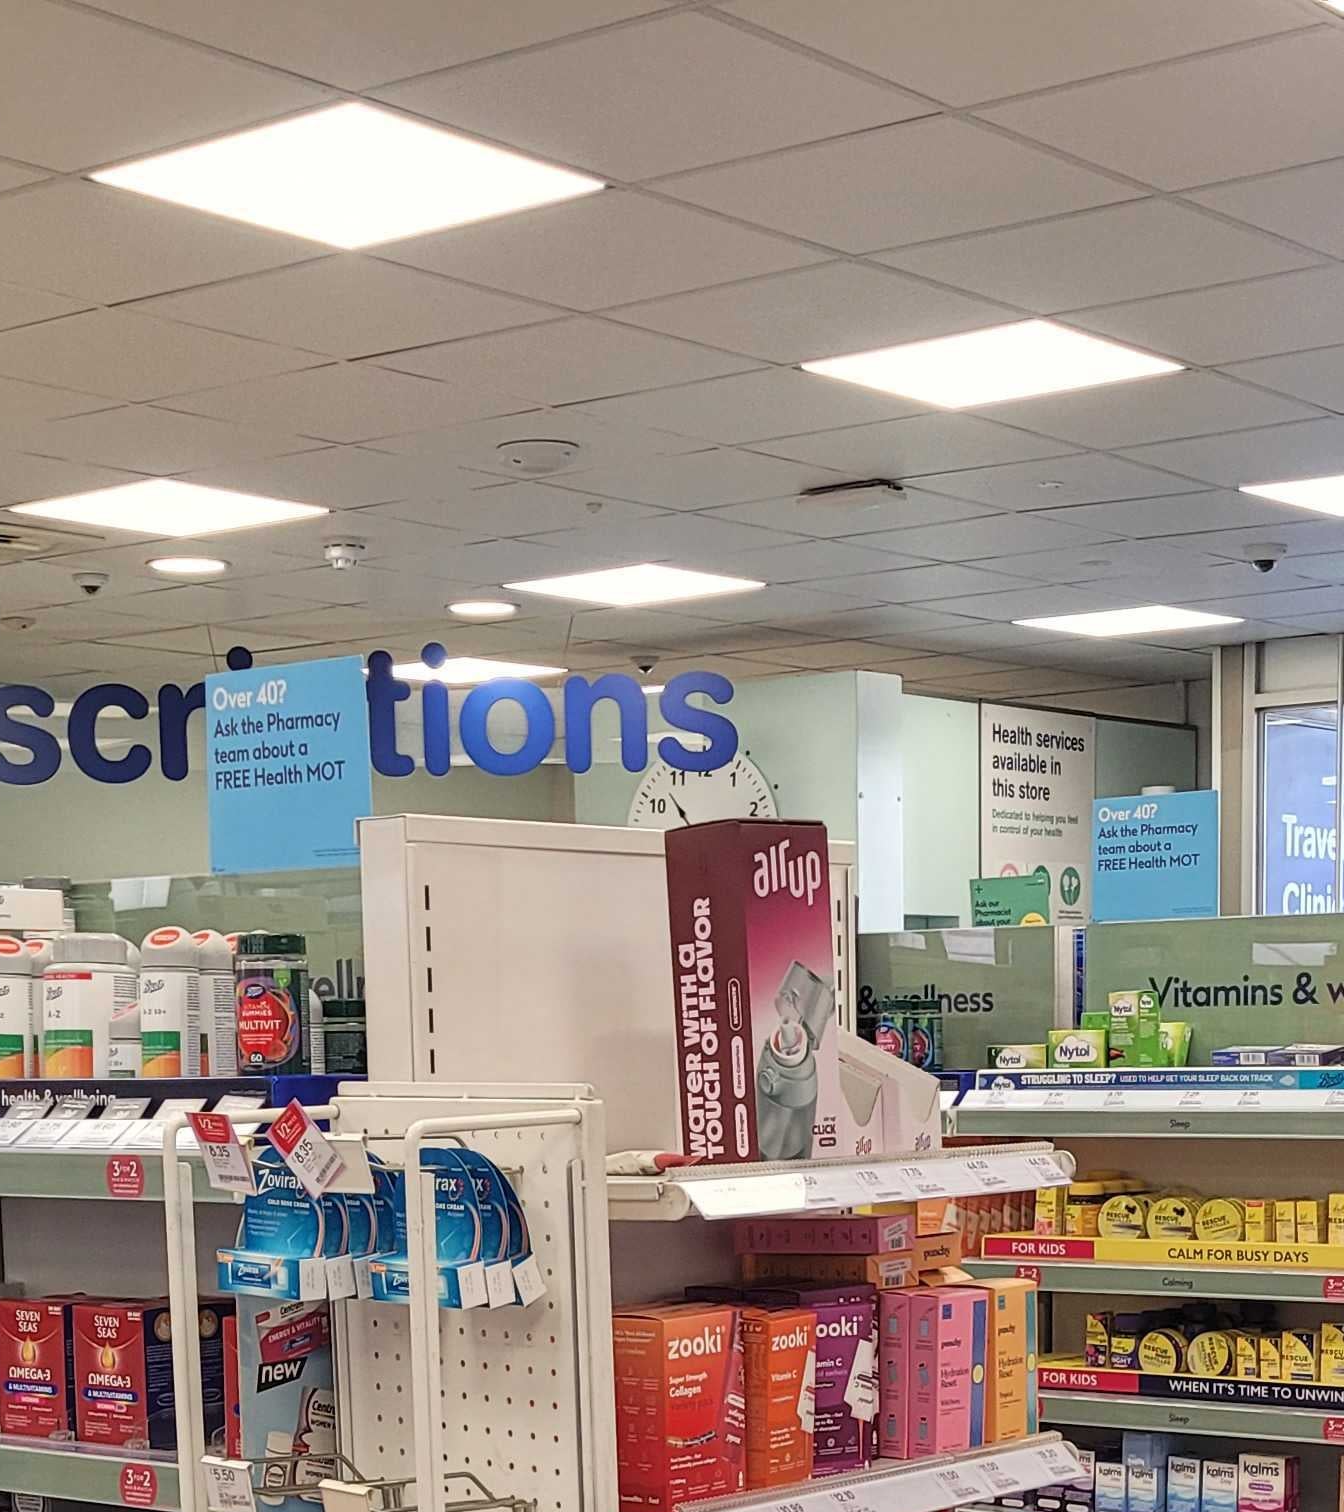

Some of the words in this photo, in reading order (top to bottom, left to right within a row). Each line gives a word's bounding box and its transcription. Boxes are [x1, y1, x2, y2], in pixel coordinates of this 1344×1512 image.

[213, 687, 253, 711] Over
[256, 680, 287, 705] 40?
[214, 716, 238, 739] Ask
[240, 714, 264, 736] the
[267, 711, 341, 736] Pharmacy
[992, 723, 1033, 746] Health
[1035, 731, 1085, 752] services
[214, 746, 249, 763] team
[252, 741, 295, 760] about
[298, 744, 308, 757] a
[992, 754, 1047, 775] available
[1050, 759, 1061, 776] in
[215, 770, 251, 790] FREE
[254, 764, 304, 787] Health
[306, 761, 345, 783] MOT
[670, 771, 685, 785] 11
[992, 780, 1015, 799] this
[1018, 783, 1050, 801] store
[649, 798, 666, 814] 10
[749, 801, 758, 817] 2
[1098, 808, 1131, 822] Over
[1133, 804, 1158, 819] 40?
[1097, 826, 1118, 839] Ask
[1120, 825, 1138, 837] the
[1141, 823, 1198, 837] Pharmacy
[1098, 844, 1126, 855] team
[1128, 840, 1161, 853] about
[1098, 858, 1126, 872] FREE
[1129, 855, 1166, 870] Health
[1169, 853, 1200, 867] MOT
[1148, 976, 1283, 1008] Vitamins
[1292, 972, 1319, 1005] &
[700, 1017, 719, 1055] OF
[1059, 1042, 1091, 1061] Nytol
[1020, 1074, 1070, 1085] STRUGGLING
[1084, 1073, 1116, 1084] SLEEP?
[703, 1061, 725, 1159] TOUCH
[1012, 1242, 1034, 1255] FOR
[1038, 1242, 1066, 1255] KIDS
[1168, 1247, 1207, 1261] CALM
[1212, 1248, 1233, 1261] FOR
[1237, 1249, 1269, 1262] BUSY
[1273, 1250, 1309, 1263] DAYS
[16, 1309, 40, 1321] SEVEN
[18, 1321, 38, 1333] SEAS
[668, 1326, 722, 1360] zooki
[772, 1329, 809, 1352] zooki
[261, 1360, 301, 1383] new
[1043, 1372, 1065, 1385] FOR
[1070, 1372, 1097, 1386] KIDS
[1169, 1379, 1209, 1394] WHEN
[1213, 1382, 1234, 1396] IT'S
[1239, 1384, 1269, 1398] TIME
[1272, 1386, 1290, 1399] TO
[1243, 1460, 1280, 1479] kalms
